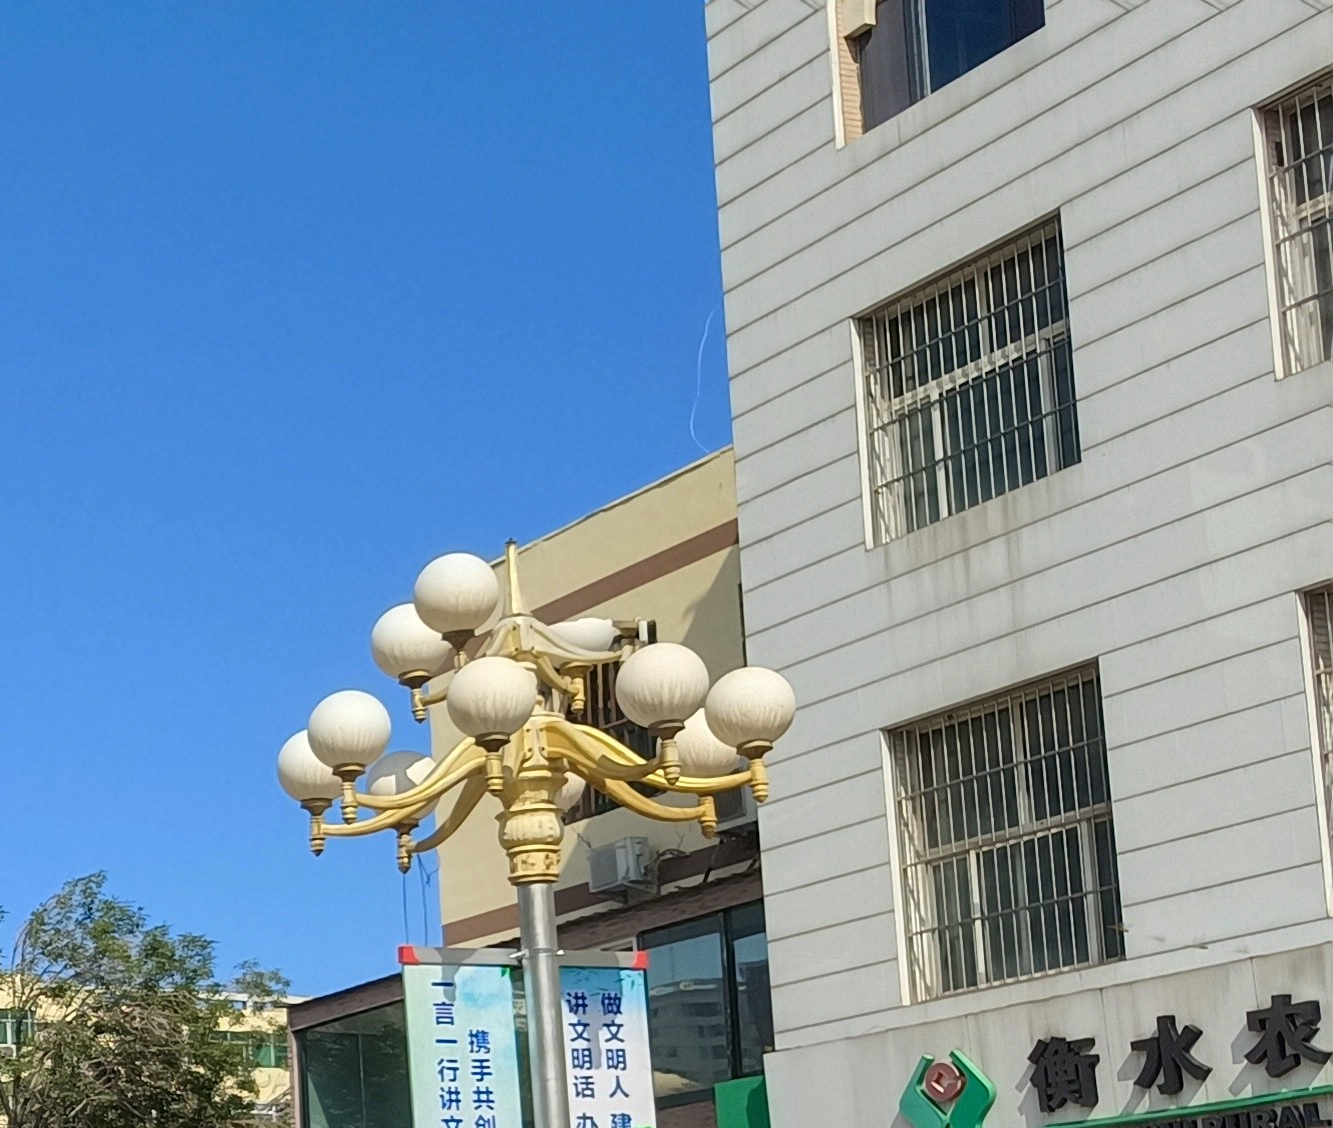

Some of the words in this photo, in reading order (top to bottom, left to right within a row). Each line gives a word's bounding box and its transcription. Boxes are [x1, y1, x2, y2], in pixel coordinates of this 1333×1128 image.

[566, 992, 596, 1099] 讲文明话
[601, 992, 630, 1099] 做文明人
[1028, 994, 1332, 1112] 衡水农
